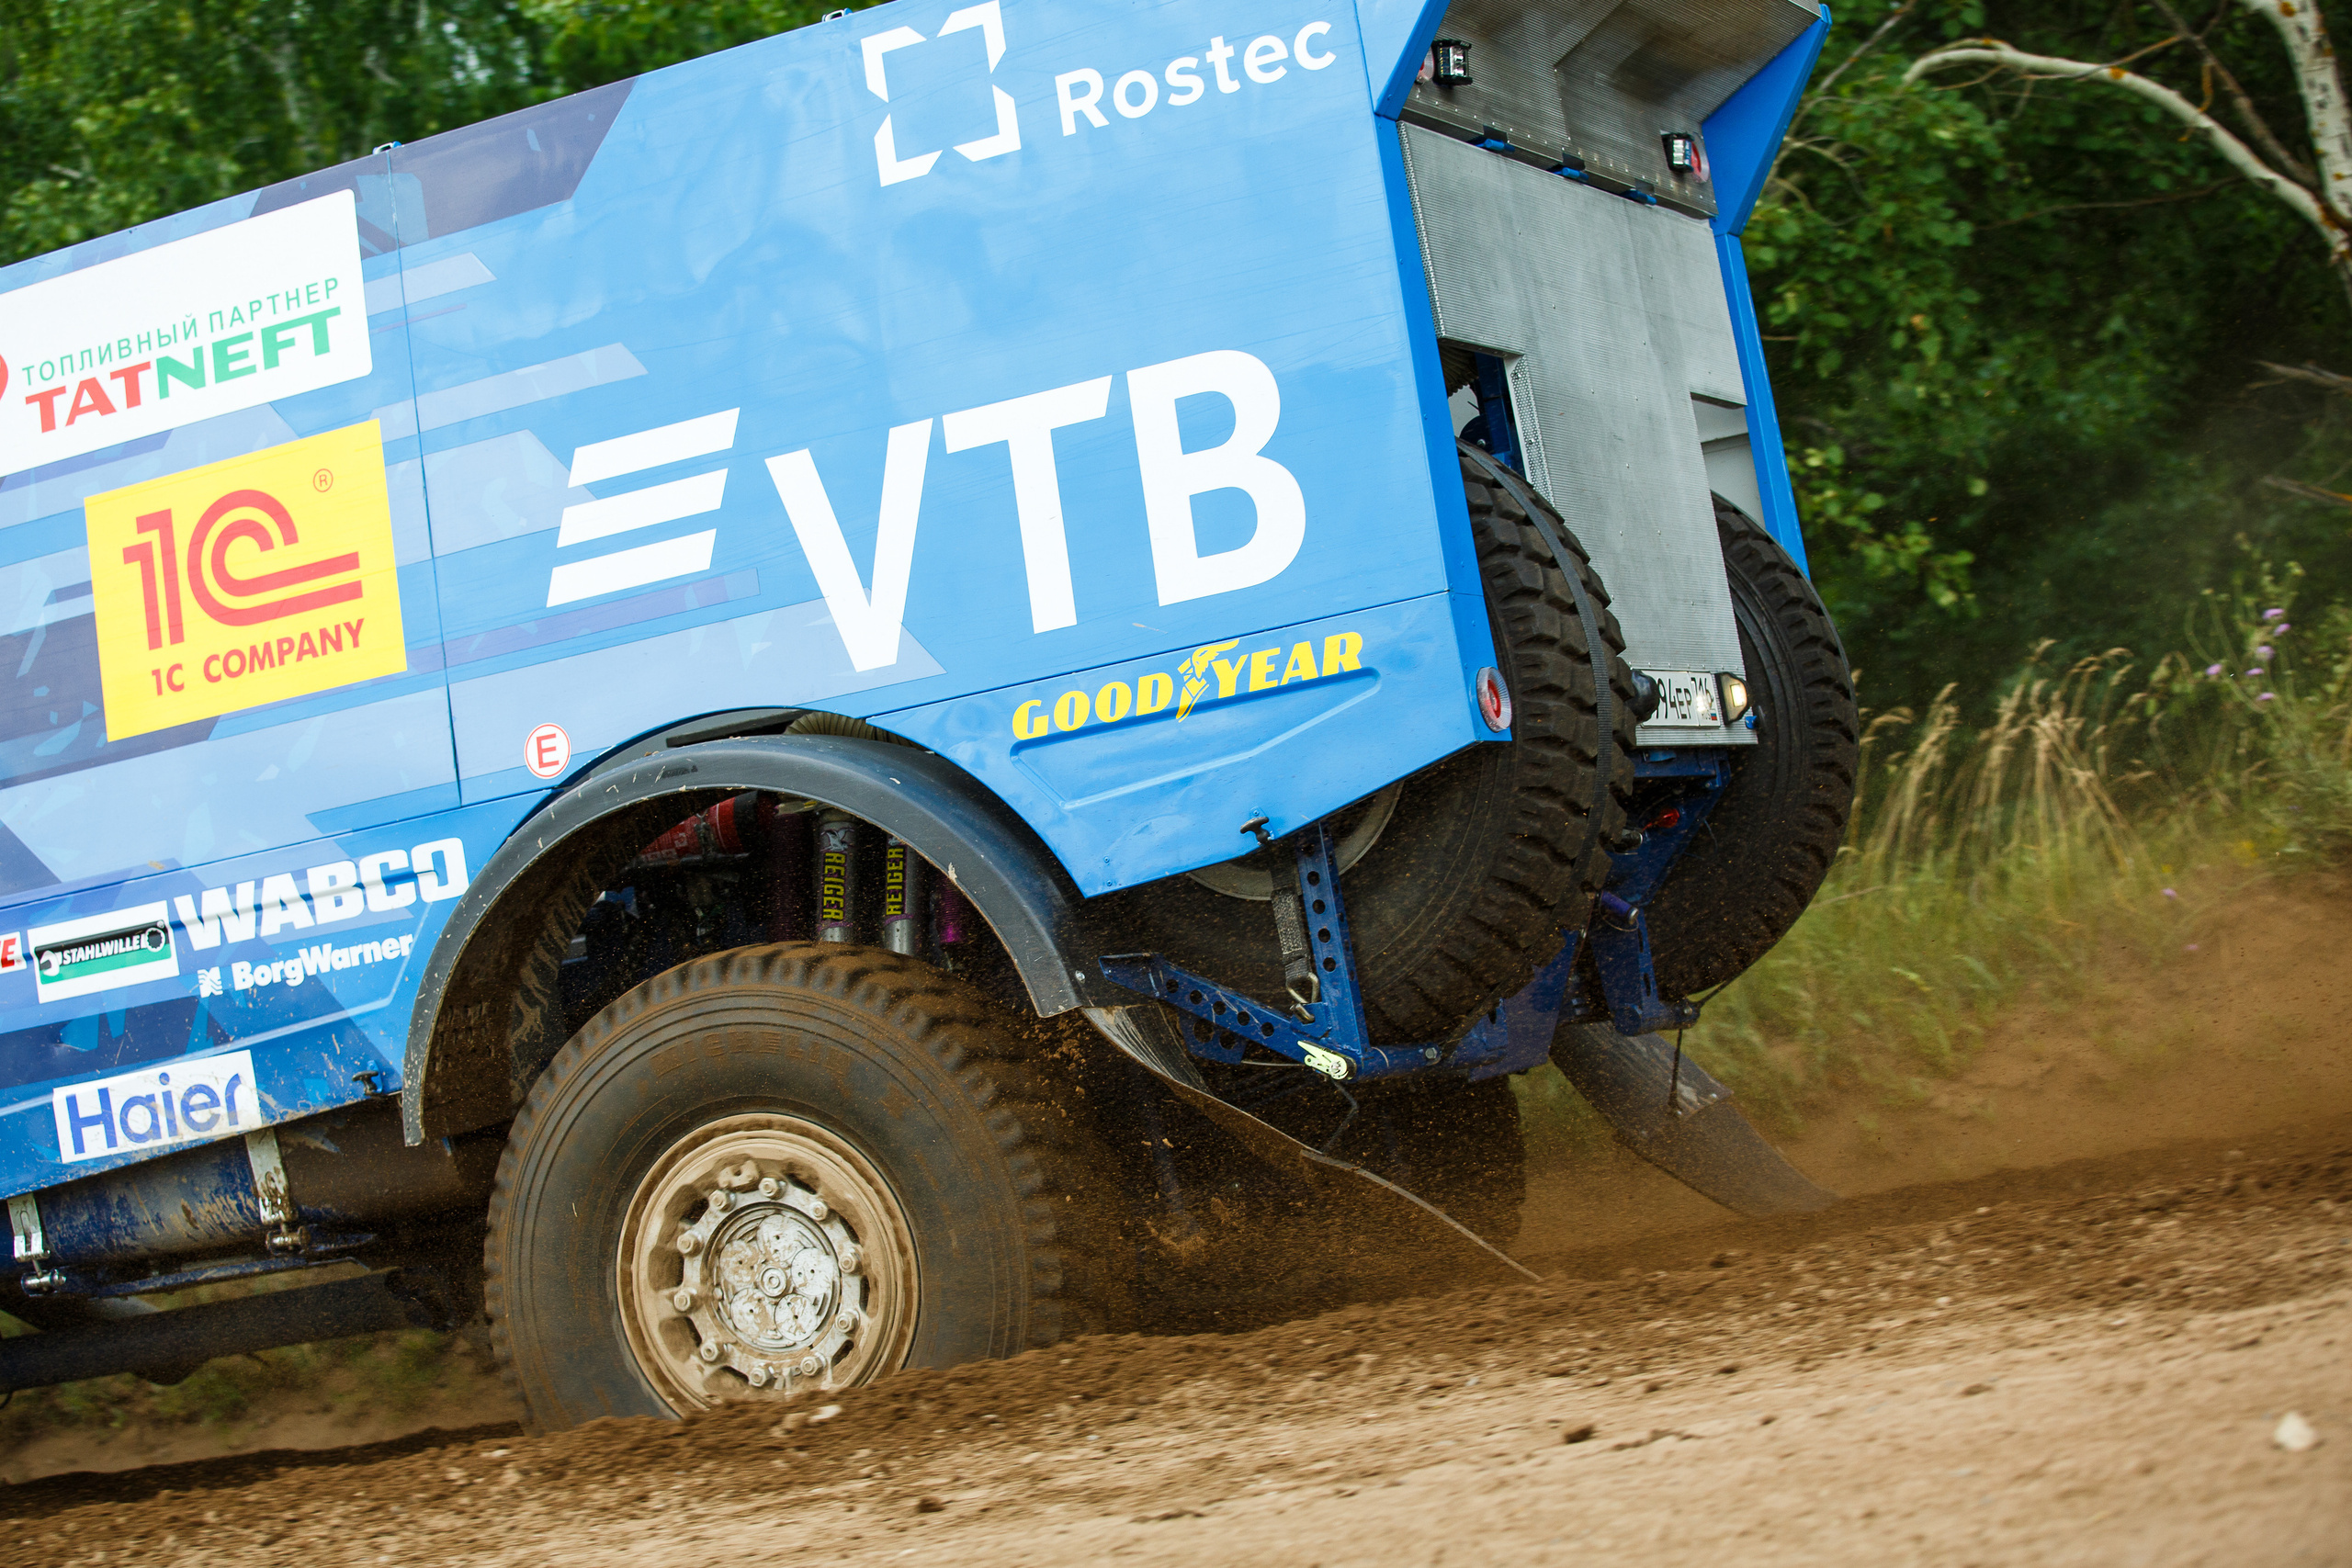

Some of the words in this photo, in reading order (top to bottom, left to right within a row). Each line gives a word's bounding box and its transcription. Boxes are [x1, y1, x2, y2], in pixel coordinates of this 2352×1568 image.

[1055, 21, 1337, 137] Rostec
[22, 313, 198, 386] ТОПЛИВНЫЙ
[209, 277, 339, 333] ПАРТНЕР
[25, 306, 341, 434] TATNEFT
[764, 349, 1306, 672] VTB
[203, 618, 365, 683] COMPANY
[536, 733, 560, 769] E
[174, 837, 469, 951] WABCO
[822, 852, 845, 920] REIGER
[886, 848, 904, 916] REIGER
[232, 933, 413, 991] BorgWarner
[65, 1072, 242, 1155] Haier
